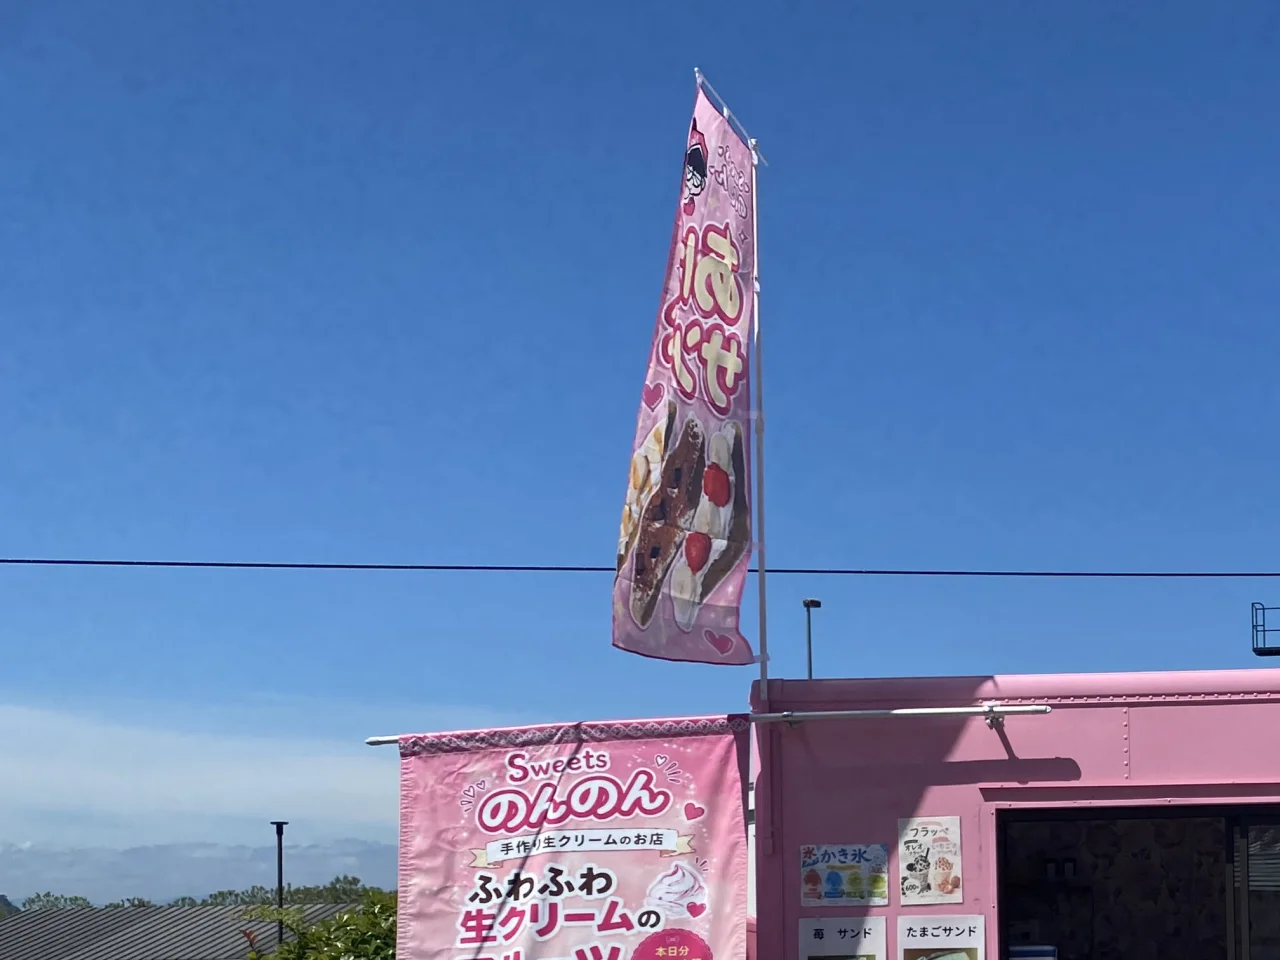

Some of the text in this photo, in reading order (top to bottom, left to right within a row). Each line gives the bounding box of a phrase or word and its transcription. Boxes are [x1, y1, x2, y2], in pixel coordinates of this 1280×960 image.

[508, 752, 607, 782] Sweets
[478, 772, 671, 833] のんのん
[910, 827, 949, 837] フラッペ
[501, 832, 664, 856] 手作り生クリームのお店
[820, 848, 872, 864] かき氷
[469, 867, 613, 903] ふわふわ
[460, 901, 660, 944] 生クリームの
[906, 926, 977, 938] たまごサンド
[837, 928, 872, 939] サンド
[655, 946, 689, 957] 本日分
